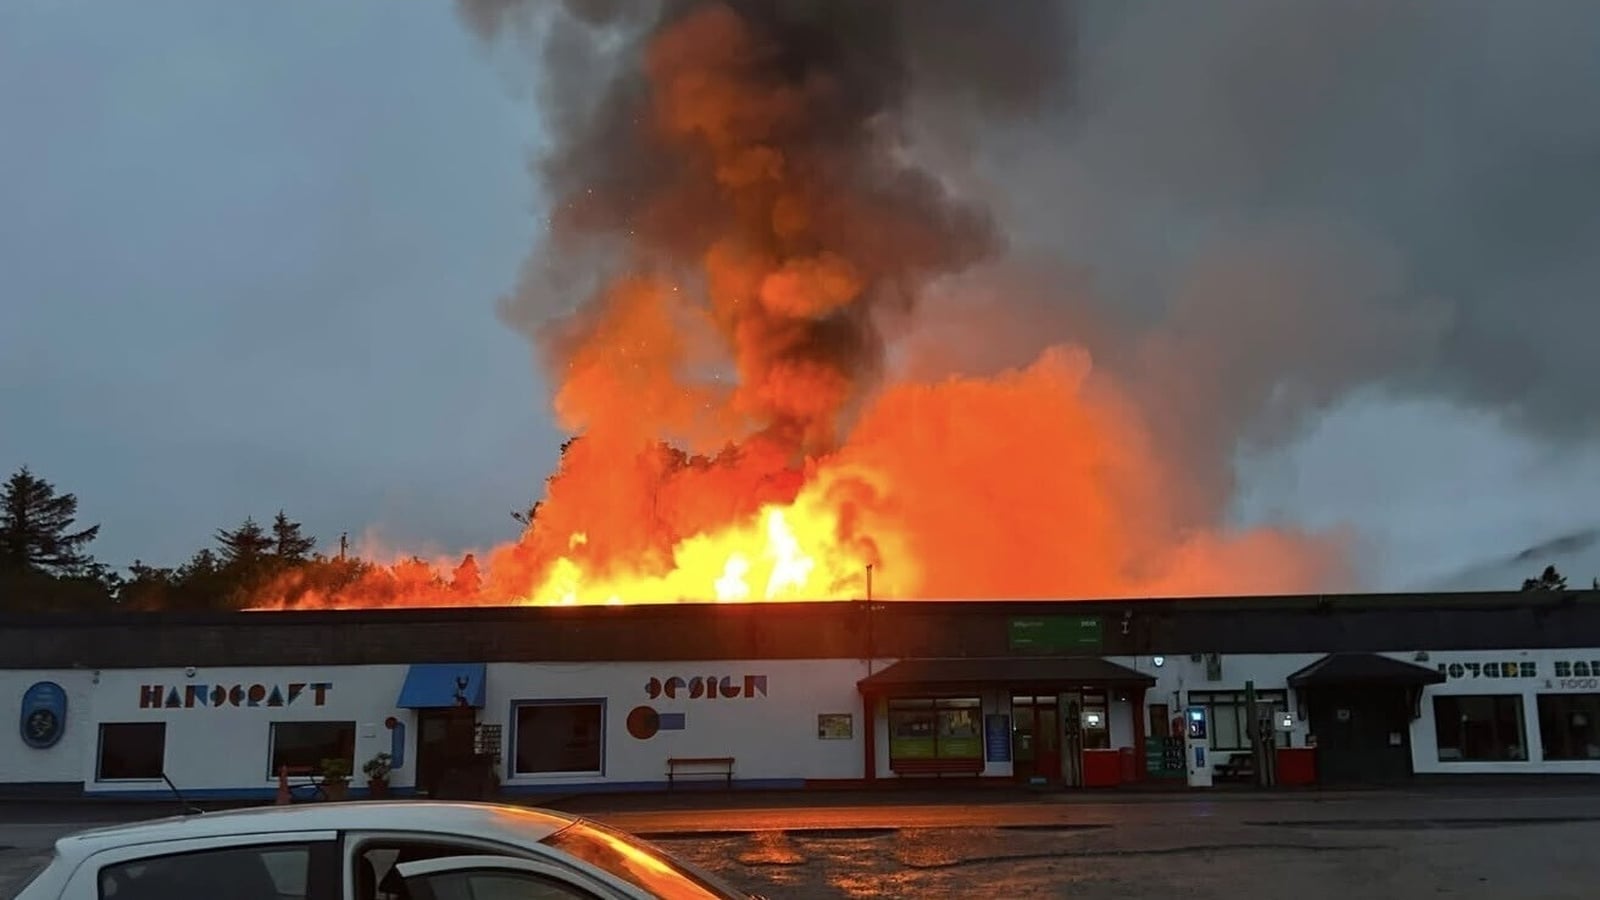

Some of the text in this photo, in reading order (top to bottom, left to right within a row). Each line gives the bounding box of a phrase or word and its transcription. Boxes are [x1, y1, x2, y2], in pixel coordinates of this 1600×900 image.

[139, 683, 332, 709] HANDCRAFT
[644, 675, 768, 700] DESIGN
[1560, 678, 1597, 689] FOOD
